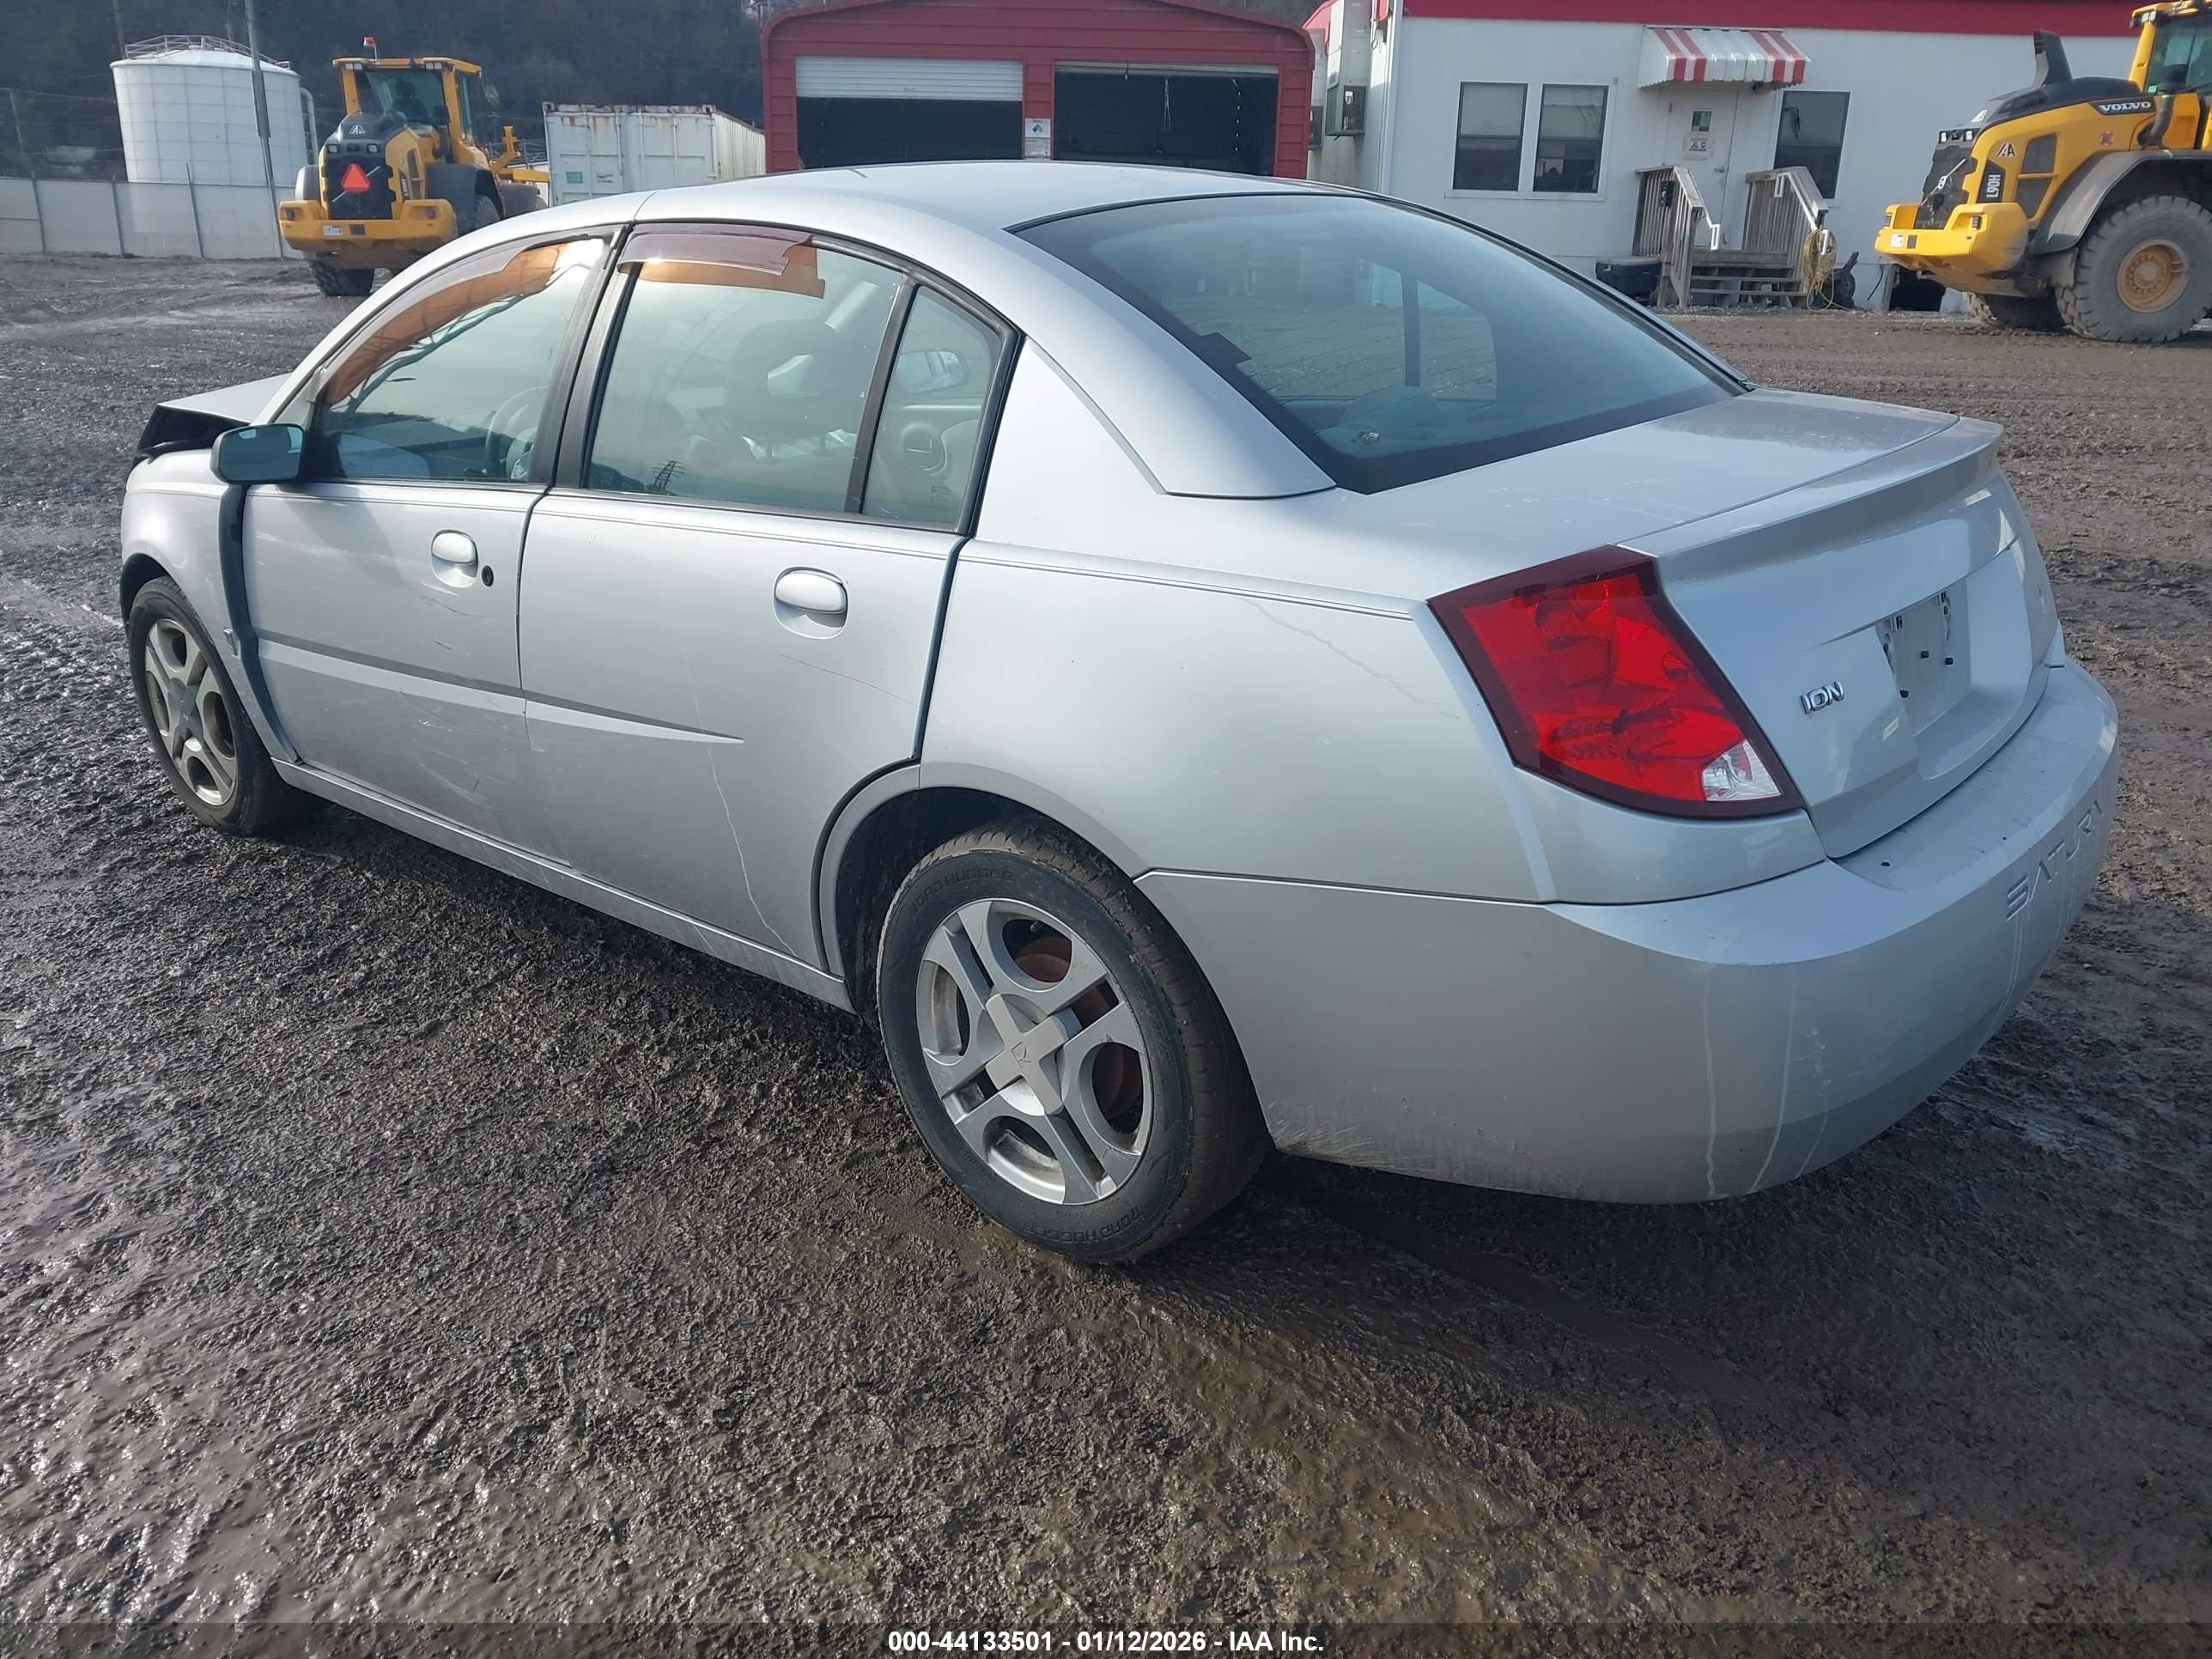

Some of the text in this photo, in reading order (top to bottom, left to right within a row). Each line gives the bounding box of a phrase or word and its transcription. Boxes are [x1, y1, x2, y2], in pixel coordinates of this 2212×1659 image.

[2100, 101, 2152, 112] VOLVO
[1985, 173, 2002, 198] L90H
[1800, 681, 1844, 714] ION
